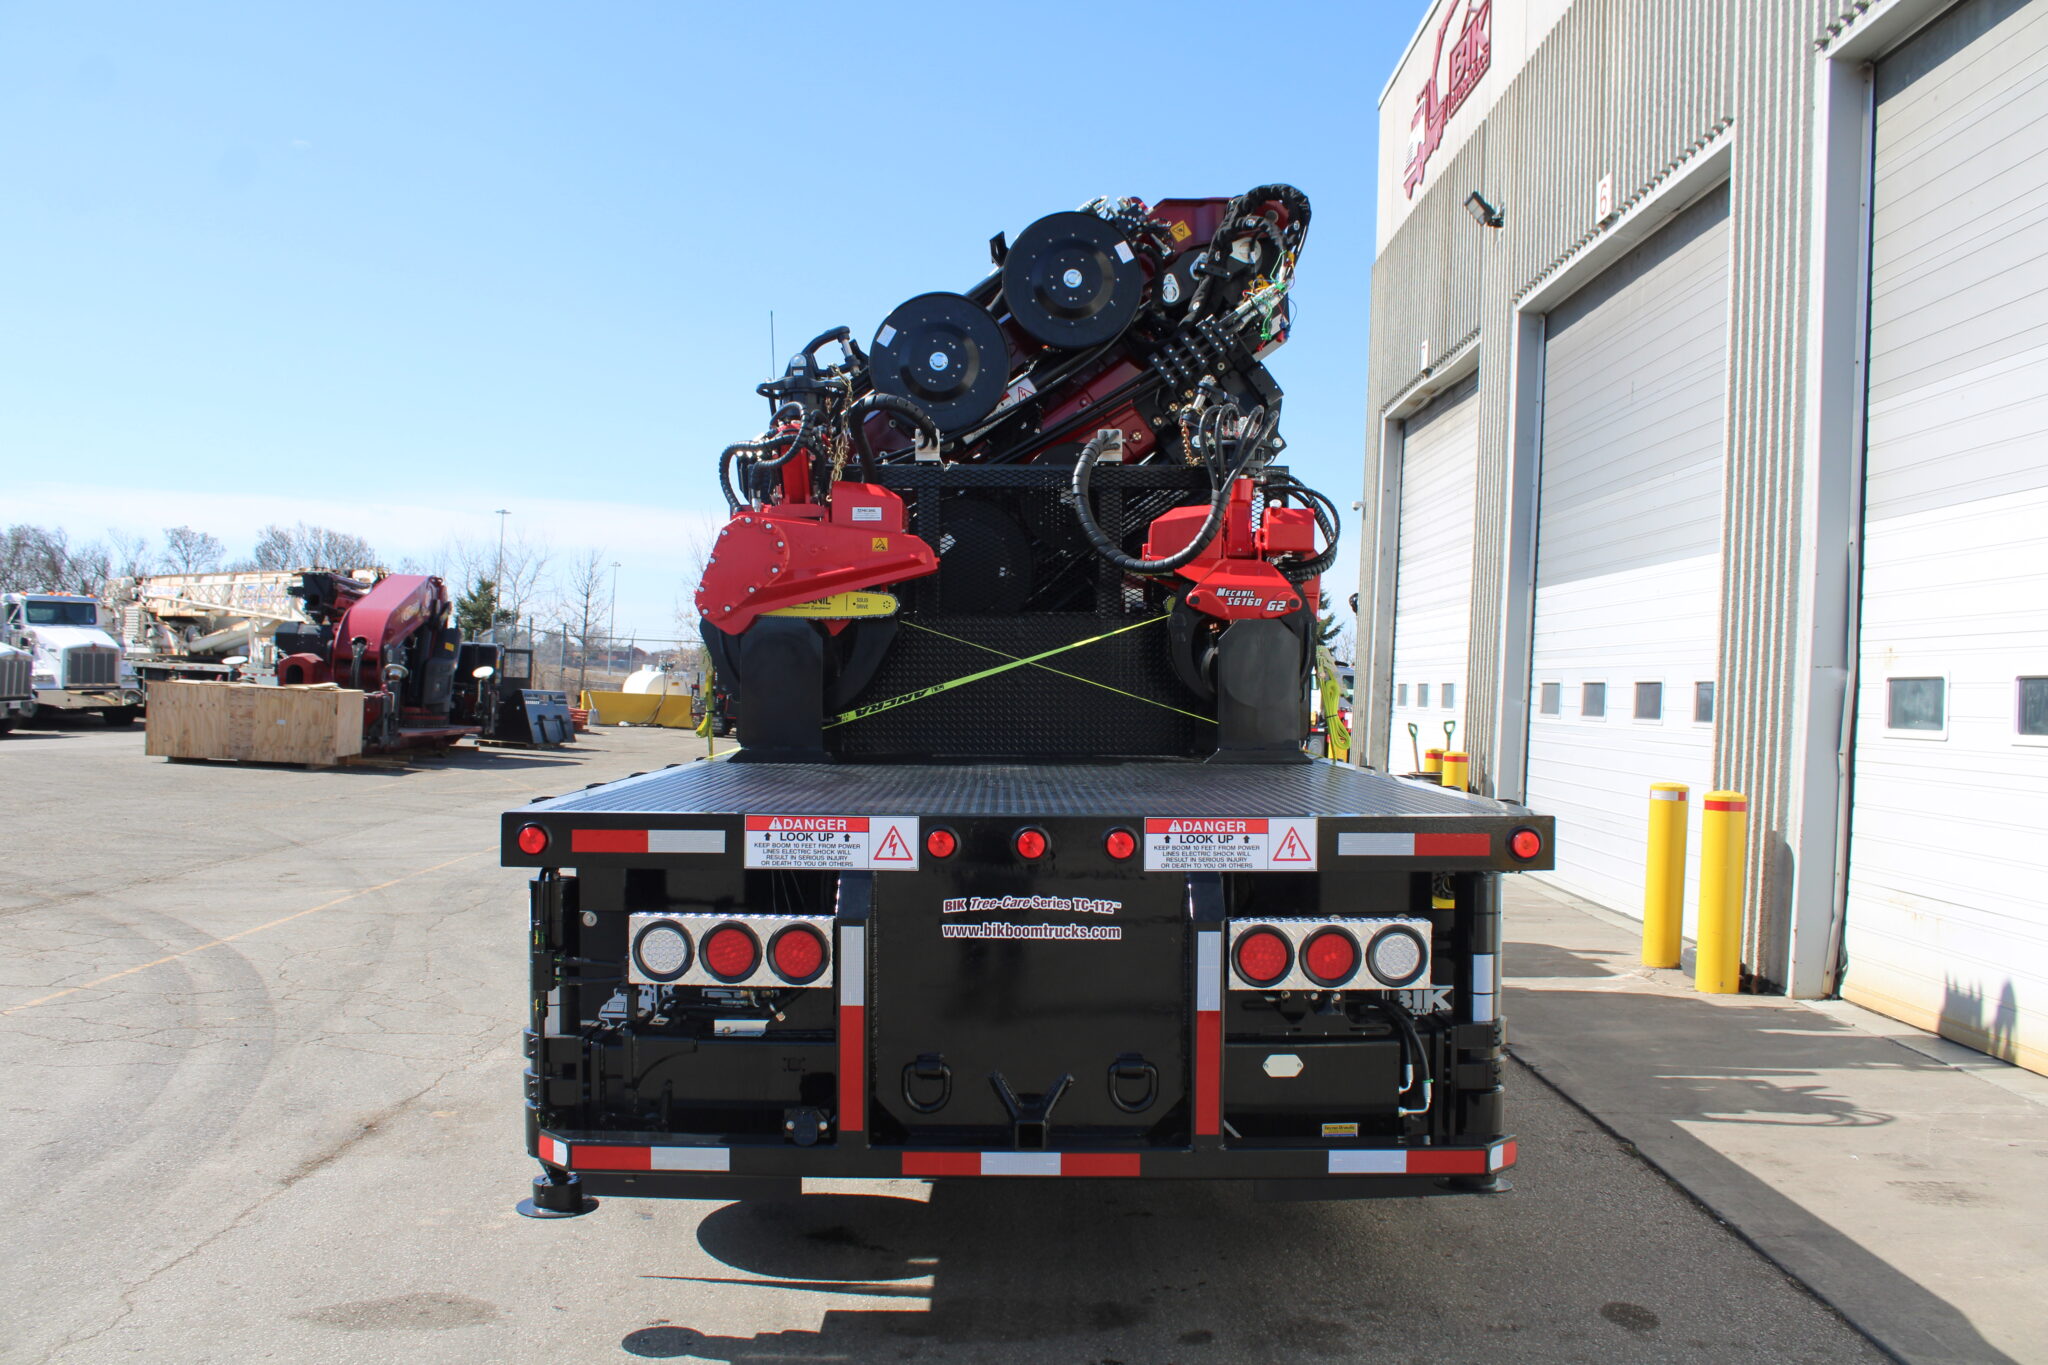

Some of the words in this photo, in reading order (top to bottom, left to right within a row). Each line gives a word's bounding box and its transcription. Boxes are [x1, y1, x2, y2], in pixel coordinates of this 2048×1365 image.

[1451, 1, 1489, 92] BIK
[1600, 183, 1607, 216] 6
[1216, 587, 1255, 598] MECANIL
[1266, 600, 1286, 611] G2
[855, 688, 930, 717] ANCRA
[783, 819, 847, 831] DANGER
[1183, 821, 1247, 833] DANGER
[780, 832, 814, 842] LOOK
[818, 833, 834, 842] UP
[1179, 834, 1213, 844] LOOK
[1218, 834, 1234, 844] UP
[943, 898, 967, 913] BIK
[969, 895, 1031, 910] Tree-Care
[1031, 896, 1071, 910] Series
[942, 922, 1121, 939] www.bikboomtrucks.com
[1399, 989, 1453, 1010] BIK
